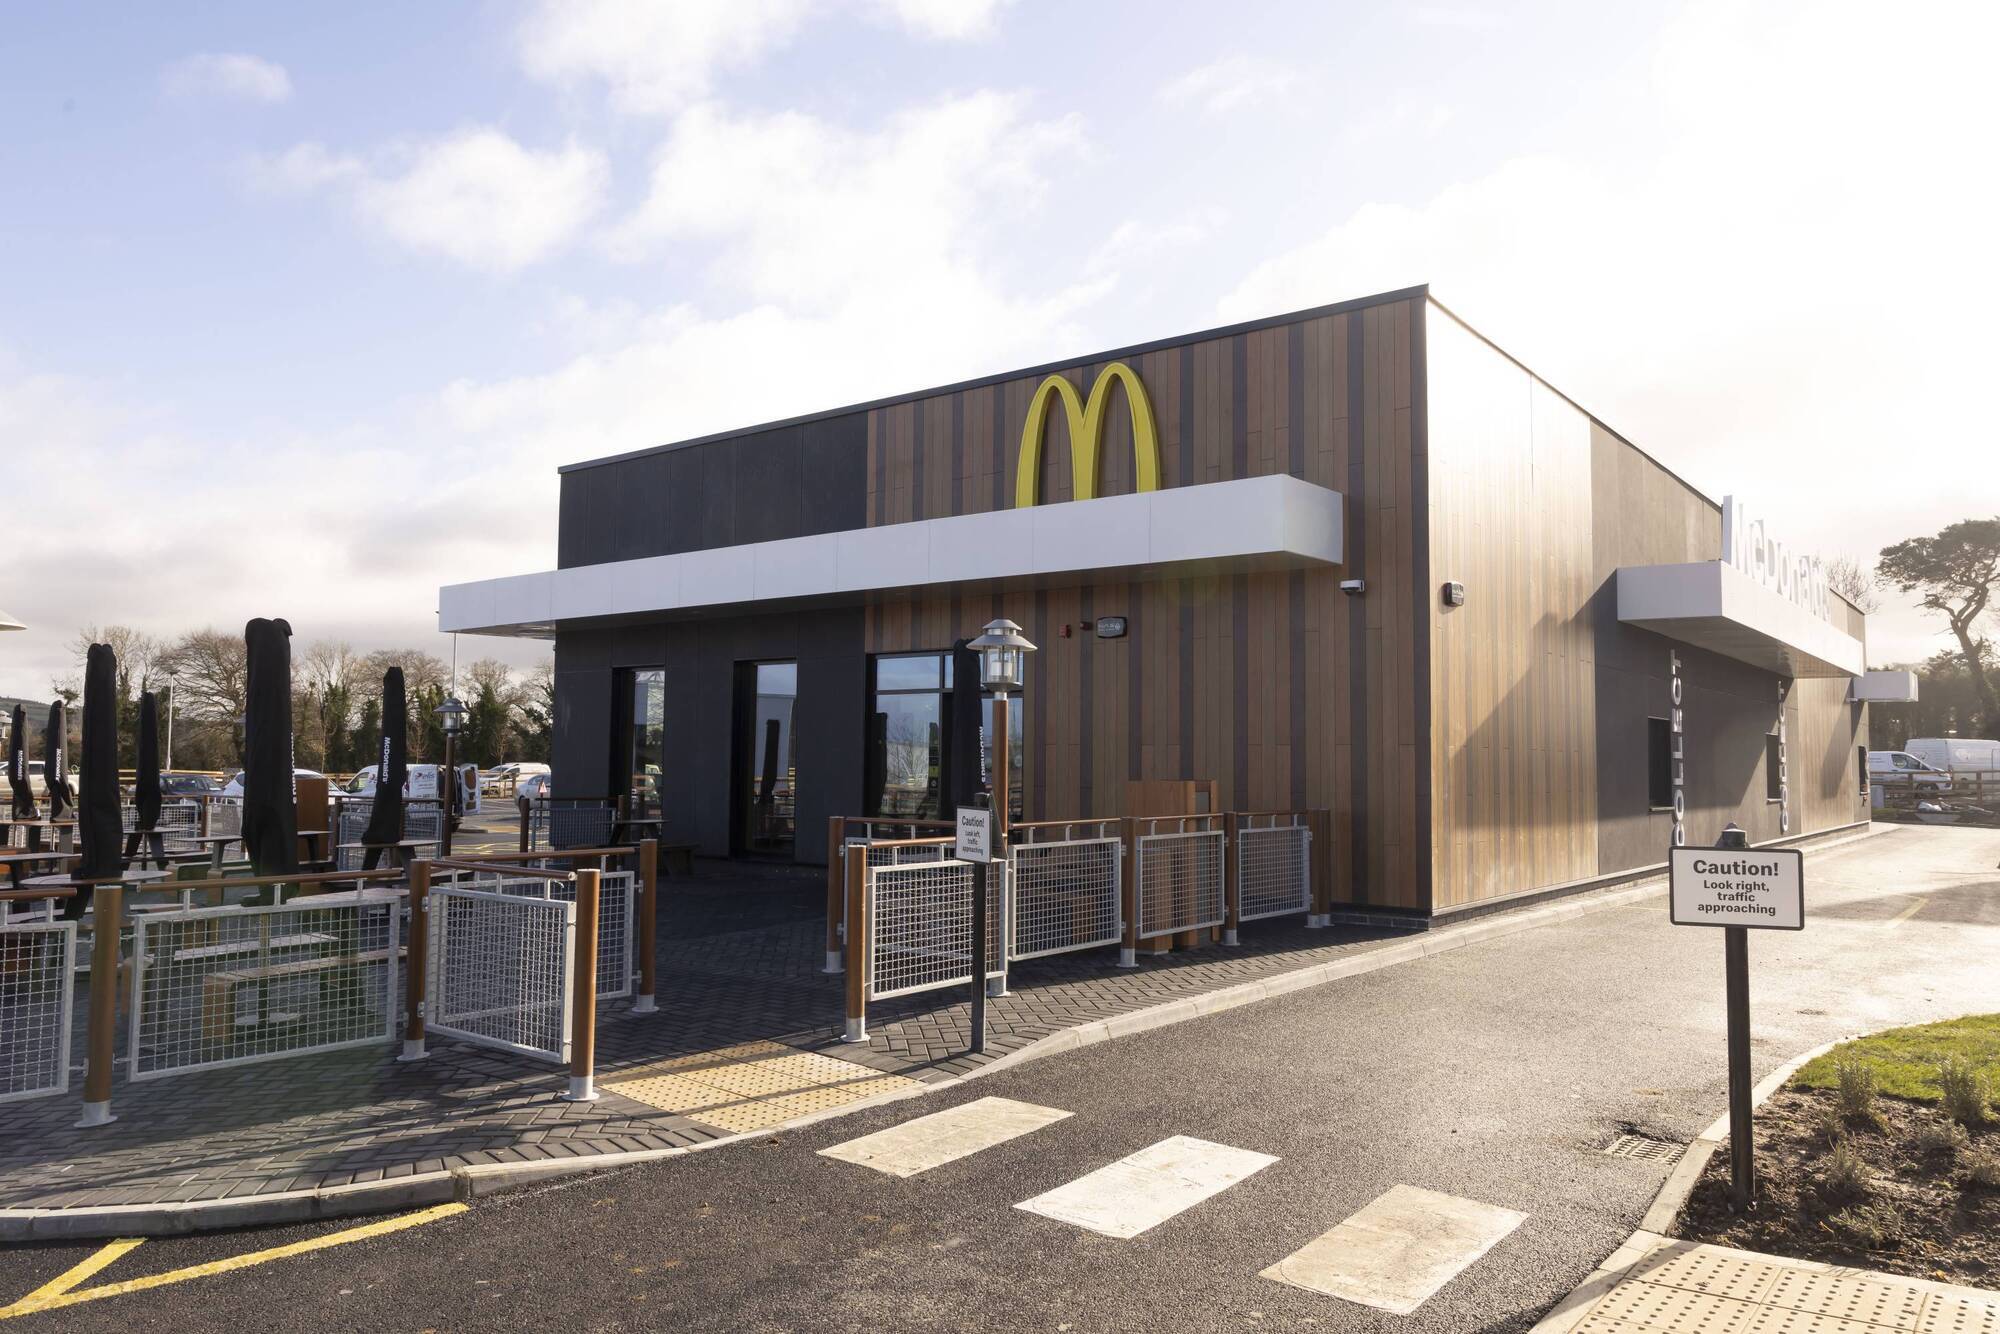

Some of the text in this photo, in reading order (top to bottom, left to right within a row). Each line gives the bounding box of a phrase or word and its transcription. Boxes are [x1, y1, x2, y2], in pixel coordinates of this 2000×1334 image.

[1672, 649, 1684, 846] COLLECT
[961, 815, 985, 828] Caution!
[962, 846, 984, 857] approaching
[1693, 859, 1779, 877] Caution!
[1704, 880, 1770, 893] Look right,
[1717, 891, 1756, 902] traffic
[1697, 903, 1776, 917] approaching
